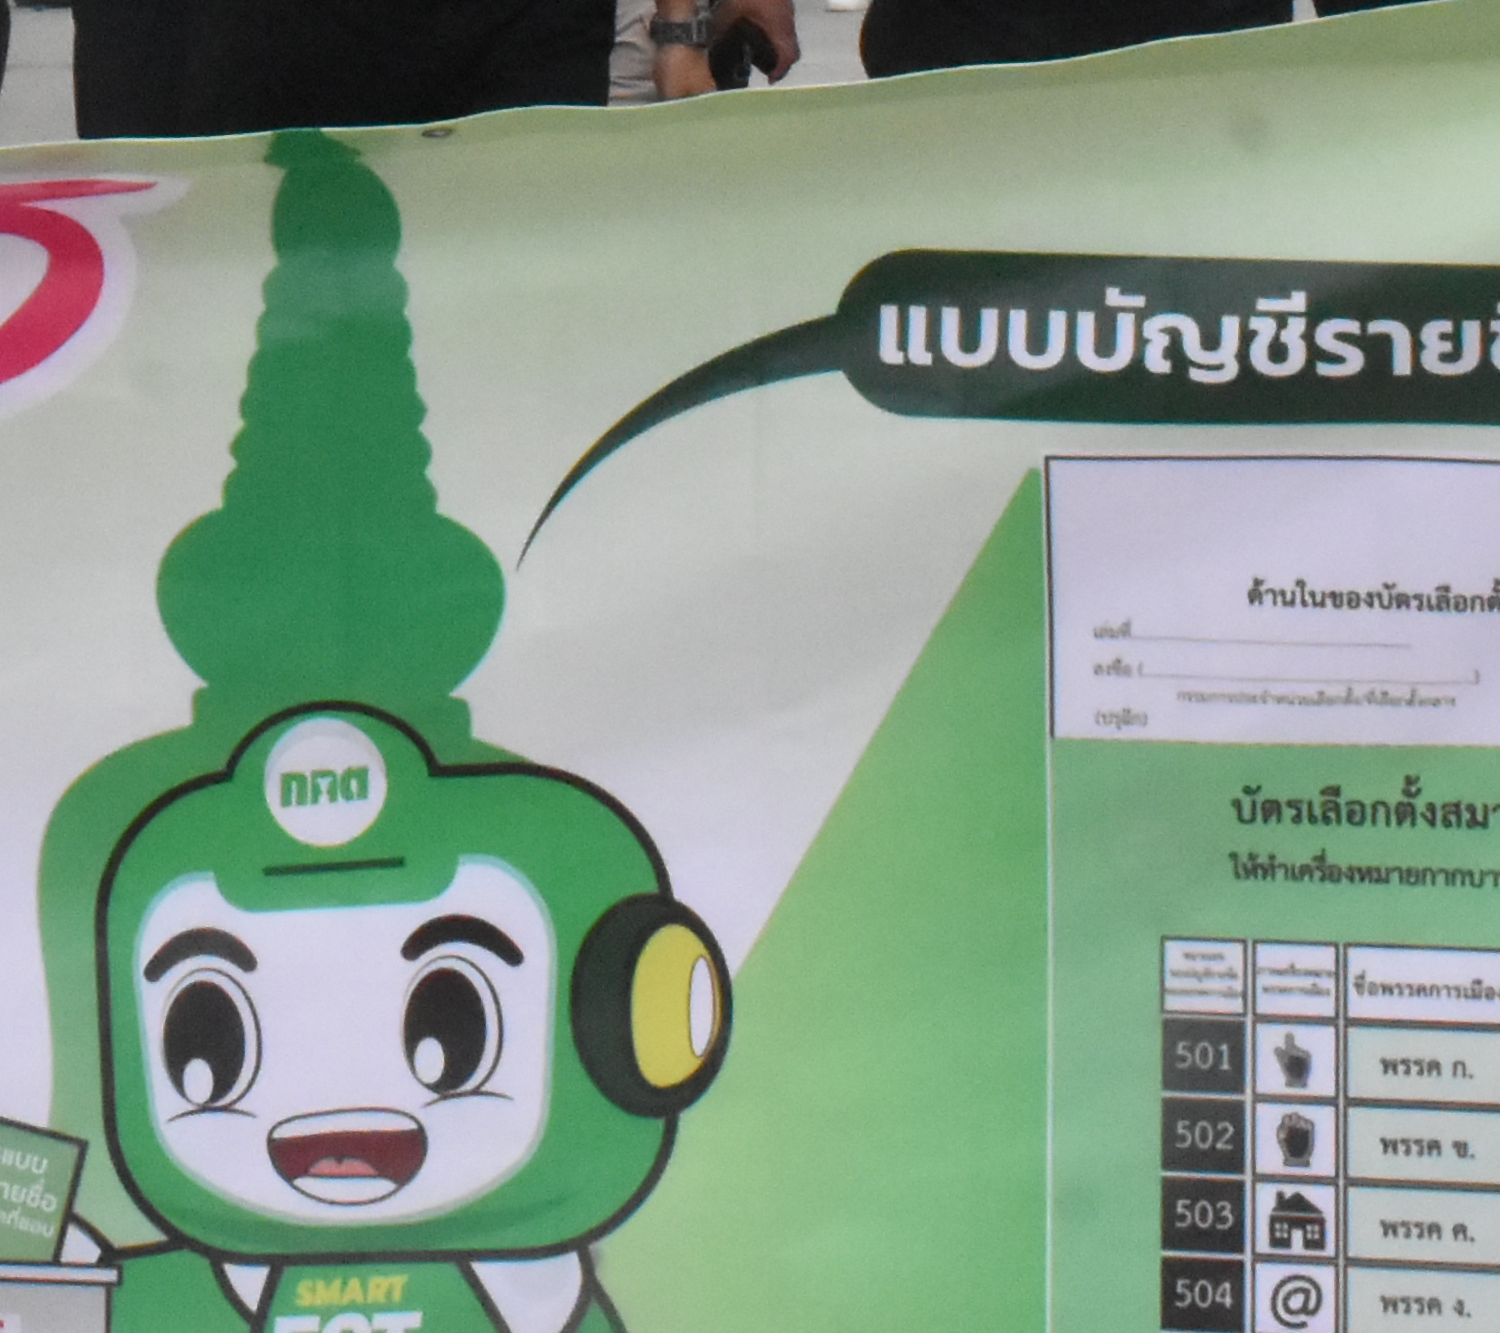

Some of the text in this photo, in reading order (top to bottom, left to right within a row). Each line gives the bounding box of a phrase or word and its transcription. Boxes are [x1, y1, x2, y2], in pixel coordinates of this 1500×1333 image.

[1174, 1041, 1233, 1072] 501
[1379, 1055, 1442, 1079] พรรค
[1174, 1120, 1235, 1151] 502
[1379, 1134, 1442, 1158] พรรค
[1174, 1199, 1235, 1230] 503
[1379, 1217, 1442, 1241] พรรค
[295, 1274, 409, 1307] SMART
[1174, 1279, 1234, 1309] 504
[1379, 1292, 1442, 1317] พรรค
